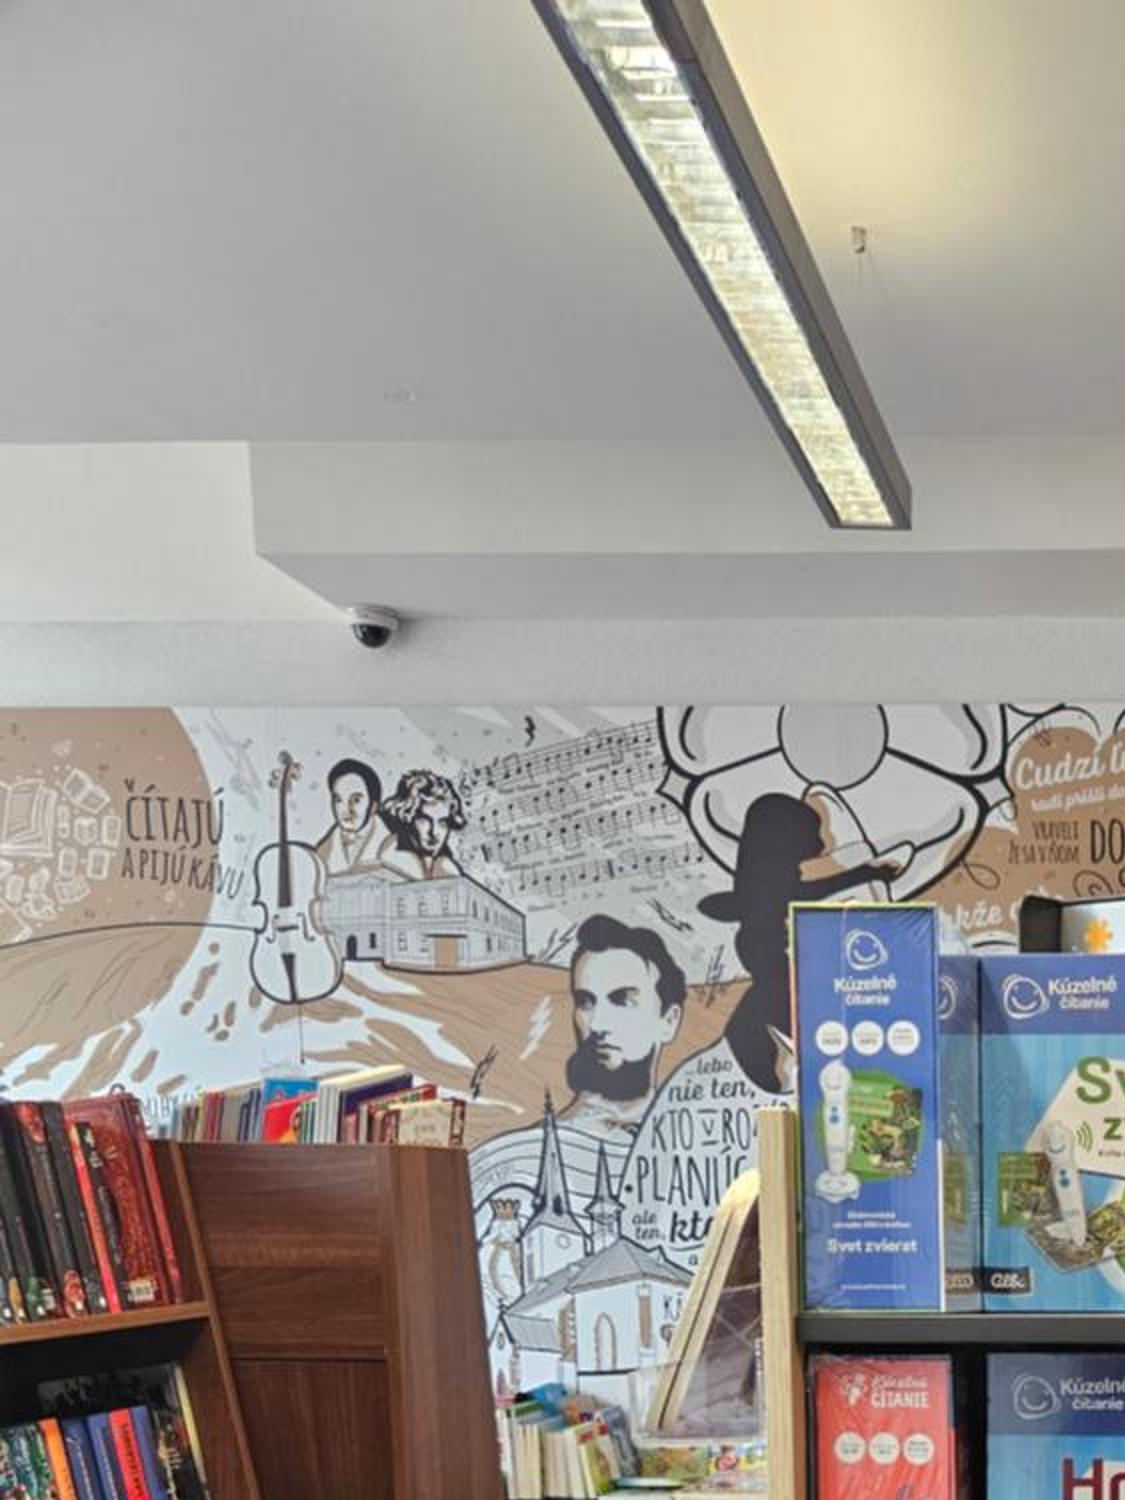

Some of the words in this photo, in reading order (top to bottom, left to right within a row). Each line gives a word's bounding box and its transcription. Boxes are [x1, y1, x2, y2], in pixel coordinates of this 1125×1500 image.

[1016, 751, 1105, 791] Cudzí
[125, 778, 225, 849] ČÍTAJÚ
[121, 847, 135, 879] A
[139, 845, 187, 886] PIJÚ
[187, 853, 245, 900] KÁVU
[668, 1079, 704, 1103] nie
[651, 1108, 695, 1151] KTO
[721, 1108, 757, 1150] RO
